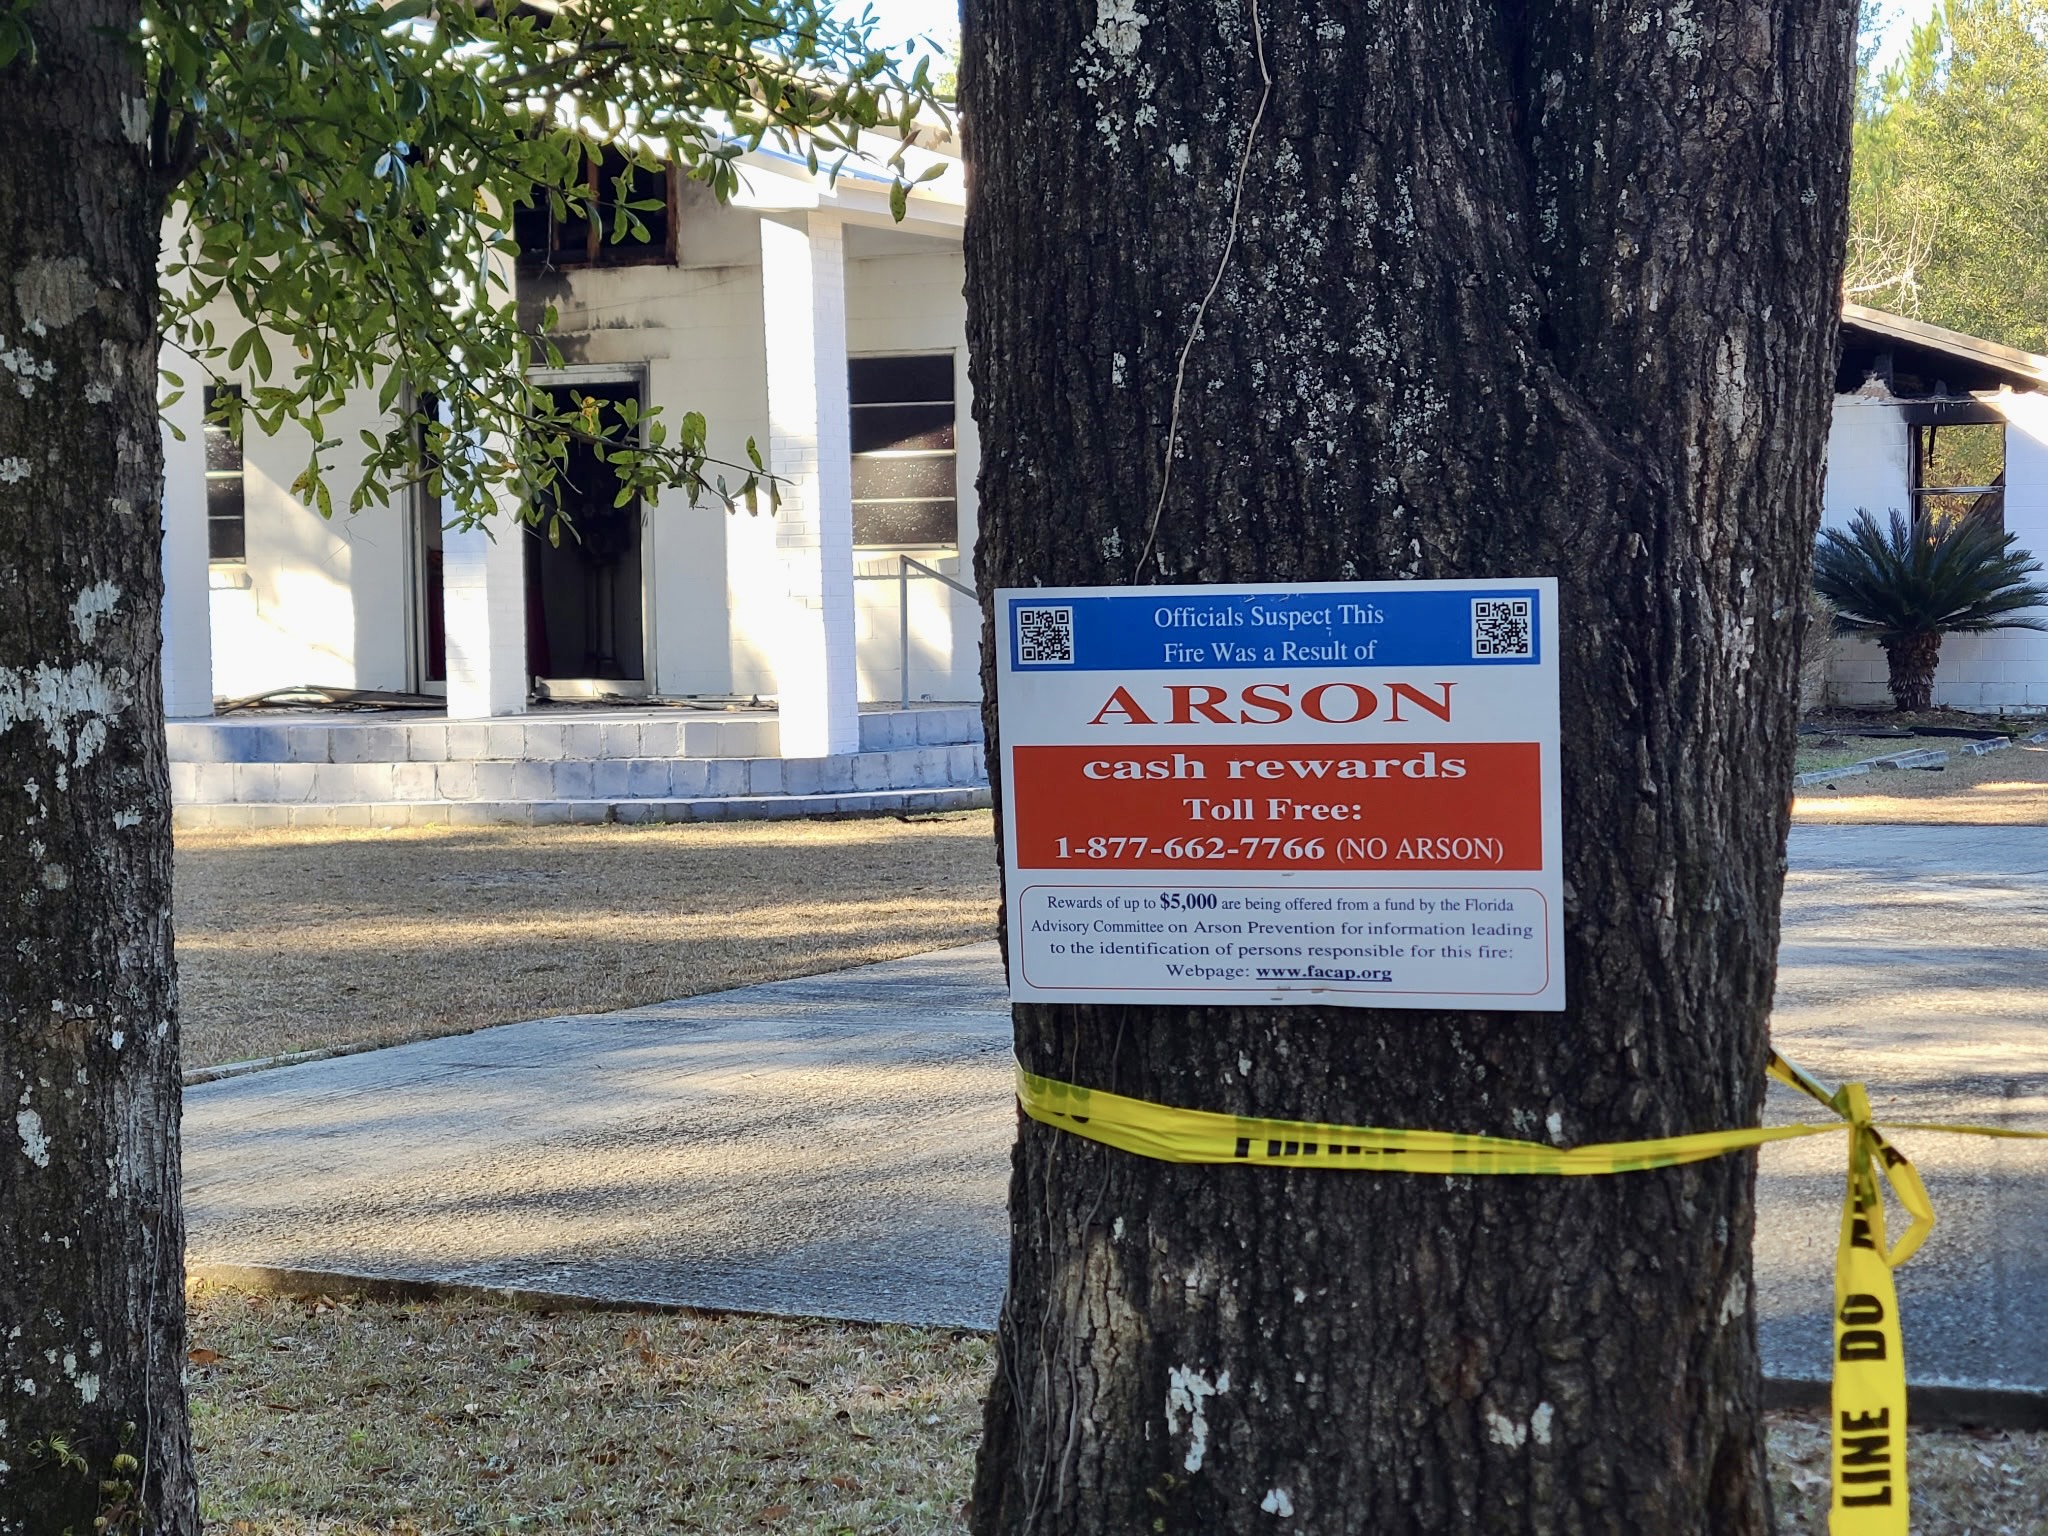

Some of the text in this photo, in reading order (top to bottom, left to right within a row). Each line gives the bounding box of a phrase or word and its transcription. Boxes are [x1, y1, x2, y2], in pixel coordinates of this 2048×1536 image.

[1155, 604, 1383, 630] Officials Suspect This
[1164, 640, 1377, 662] Fire Was a Result of
[1087, 682, 1458, 725] ARSON
[1084, 752, 1466, 780] cash rewards
[1183, 799, 1361, 820] Toll Free:
[1056, 837, 1503, 863] 1-877-662-7766 (NO ARSON)
[1048, 892, 1513, 914] Rewards of up to $5,000 are being offered from a fund by the Florida
[1032, 920, 1533, 939] Advisory Committee on Arson Prevention for information leading
[1050, 942, 1512, 960] to the identification of persons responsible for this fire:
[1166, 965, 1392, 982] Webpage: www.facap.org
[1840, 1294, 1887, 1361] DO
[1842, 1408, 1892, 1507] LINE
